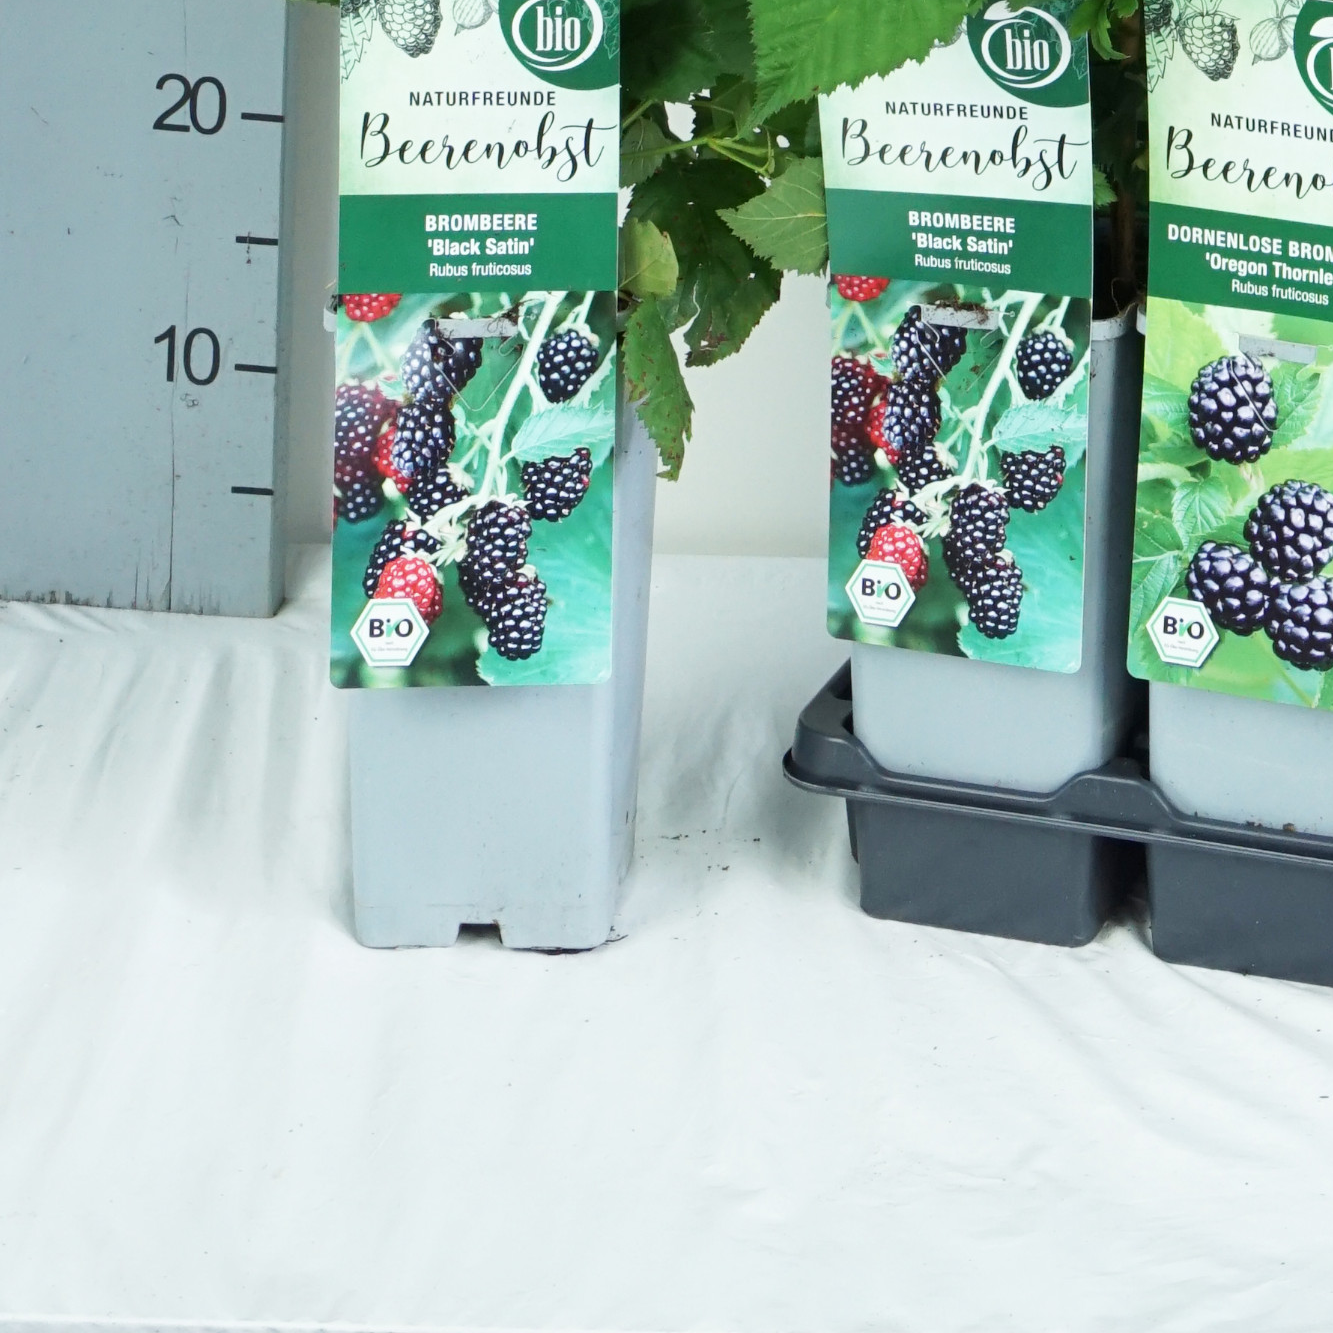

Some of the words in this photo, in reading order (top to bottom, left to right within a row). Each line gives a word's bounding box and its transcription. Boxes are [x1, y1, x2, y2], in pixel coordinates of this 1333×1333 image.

[536, 6, 581, 51] bio
[1004, 28, 1050, 70] bio
[153, 72, 227, 135] 20
[409, 91, 556, 106] NATURFREUNDE
[885, 101, 1028, 120] NATURFREUNDE
[360, 111, 618, 182] Beerenobst
[841, 117, 1090, 191] Beerenobst
[425, 214, 538, 232] BROMBEERE
[908, 210, 1016, 233] BROMBEERE
[428, 238, 480, 256] 'Black
[485, 237, 534, 255] Satin'
[911, 232, 963, 251] 'Black
[966, 236, 1013, 255] Satin'
[1168, 223, 1283, 255] DORNENLOSE
[429, 263, 468, 277] Rubus
[472, 262, 532, 276] fruticosus
[914, 254, 951, 269] Rubus
[954, 256, 1012, 274] fruticosus
[1205, 252, 1268, 279] 'Oregon
[1231, 279, 1268, 297] Rubus
[1271, 284, 1329, 305] fruticosus
[153, 325, 221, 386] 10
